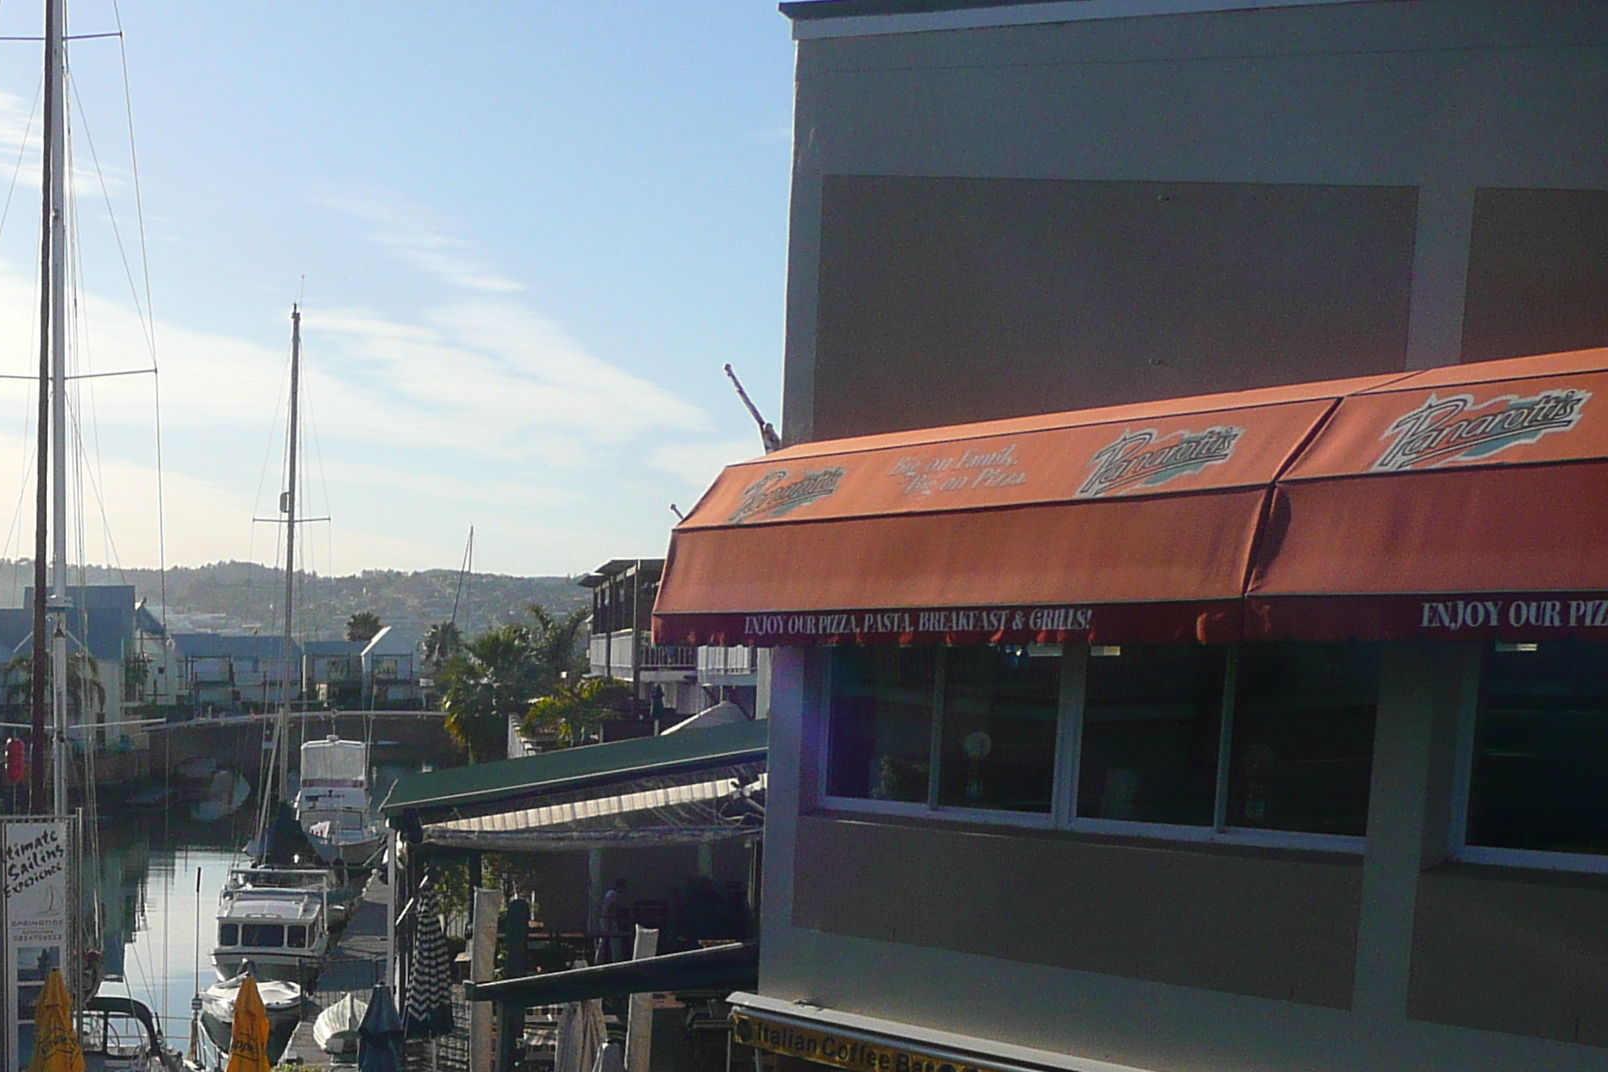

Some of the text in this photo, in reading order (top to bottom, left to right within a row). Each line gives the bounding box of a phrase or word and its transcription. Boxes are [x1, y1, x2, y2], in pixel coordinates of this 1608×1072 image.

[1378, 388, 1581, 469] Panarottis
[1080, 426, 1239, 495] Panarottis
[744, 616, 786, 636] ENJOY
[788, 615, 816, 634] OUR
[918, 609, 1009, 632] BREAKFAST
[1012, 610, 1026, 630] &
[1029, 608, 1093, 631] GRILLS!
[1419, 600, 1503, 631] ENJOY
[1509, 600, 1563, 628] OUR
[757, 1021, 817, 1053] Italian
[822, 1035, 890, 1070] Coffee
